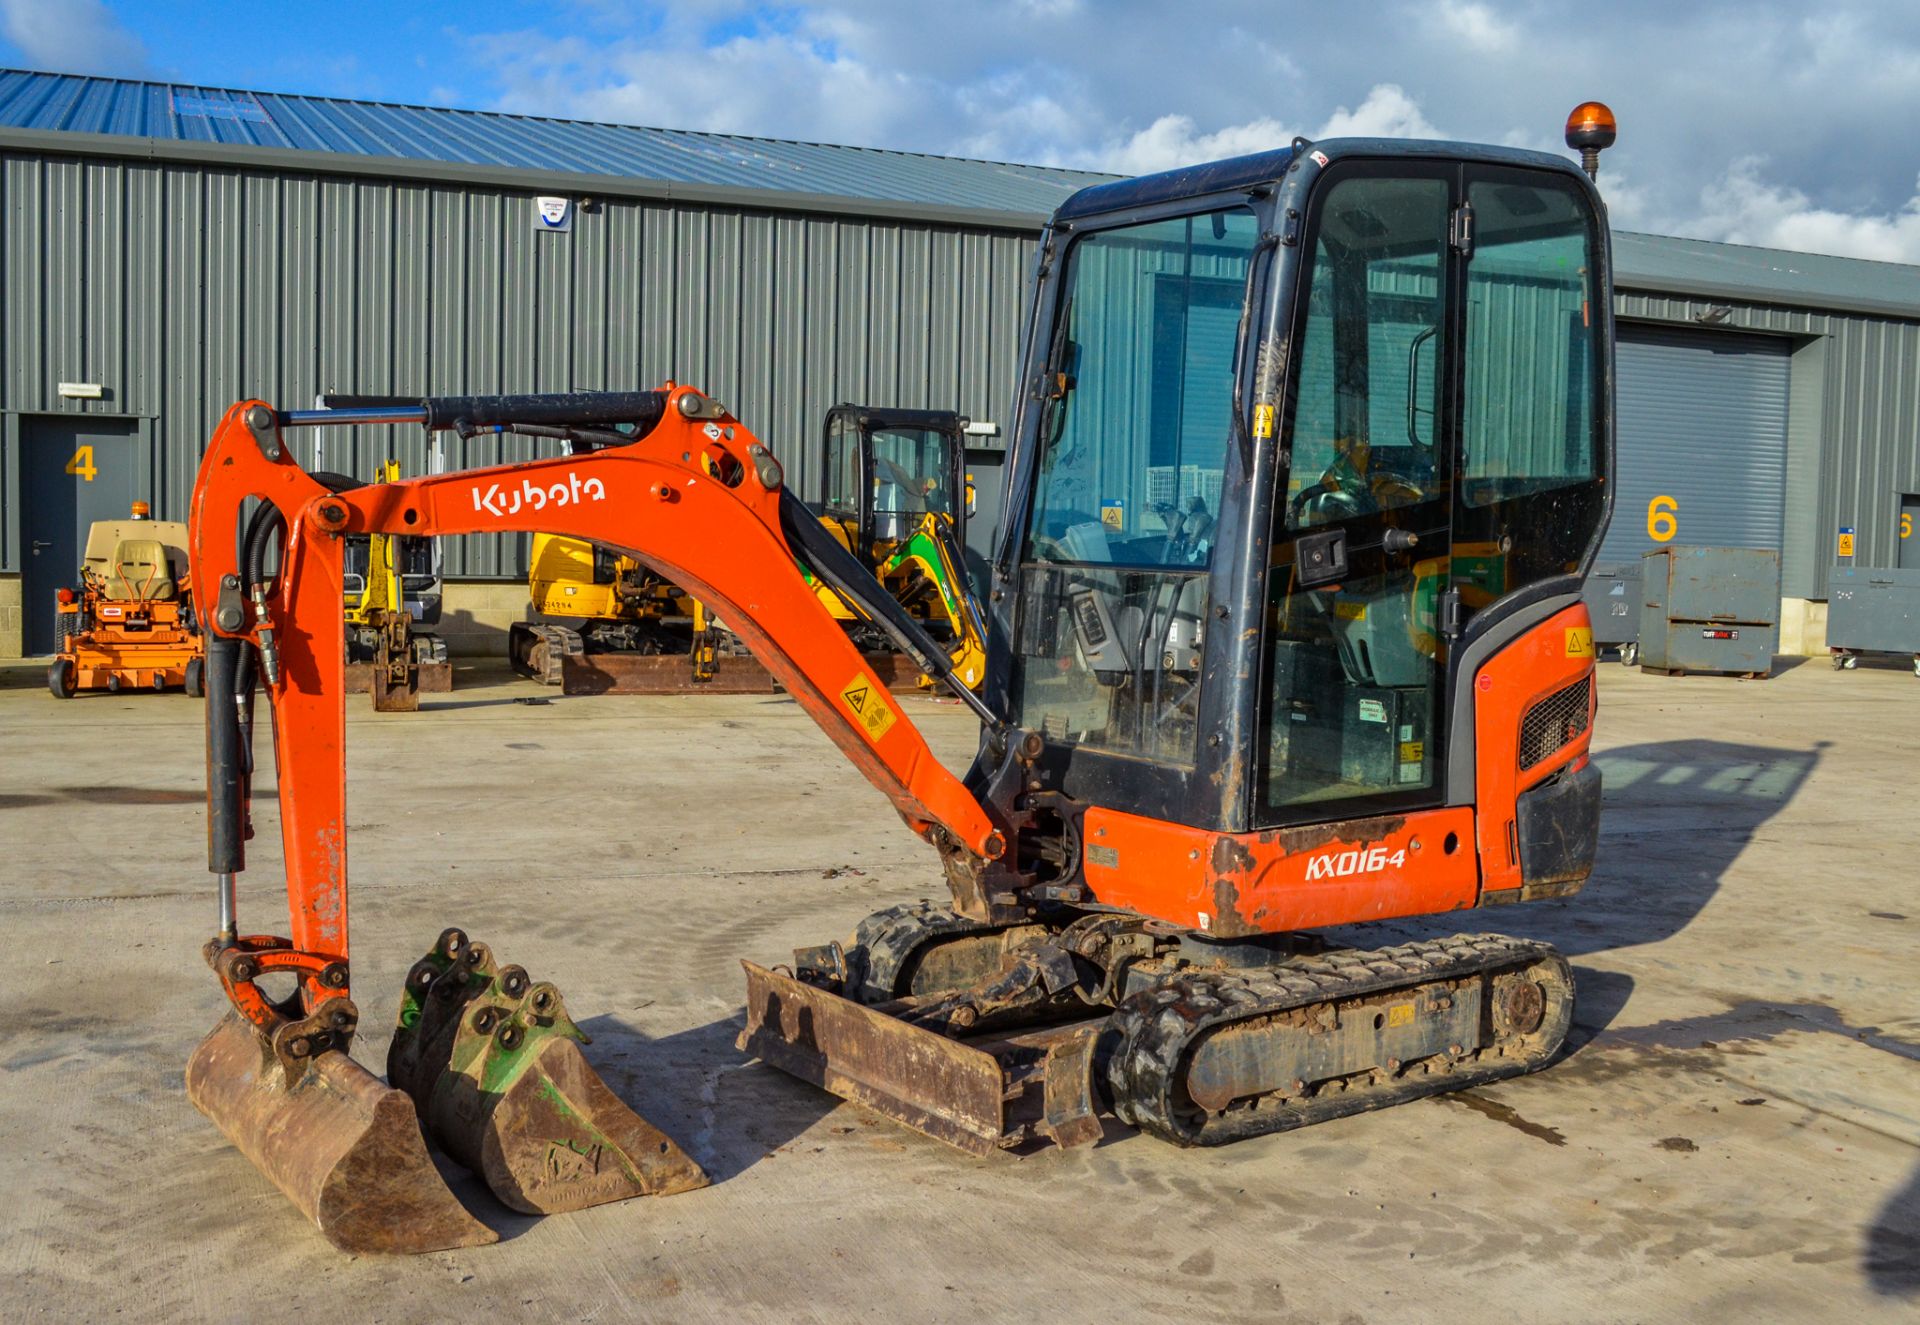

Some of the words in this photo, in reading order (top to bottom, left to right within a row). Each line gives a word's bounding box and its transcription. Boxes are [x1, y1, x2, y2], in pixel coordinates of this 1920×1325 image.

[65, 445, 97, 481] 4
[472, 472, 605, 516] Kubota
[1647, 495, 1678, 542] 6
[1305, 847, 1405, 881] KX016-4
